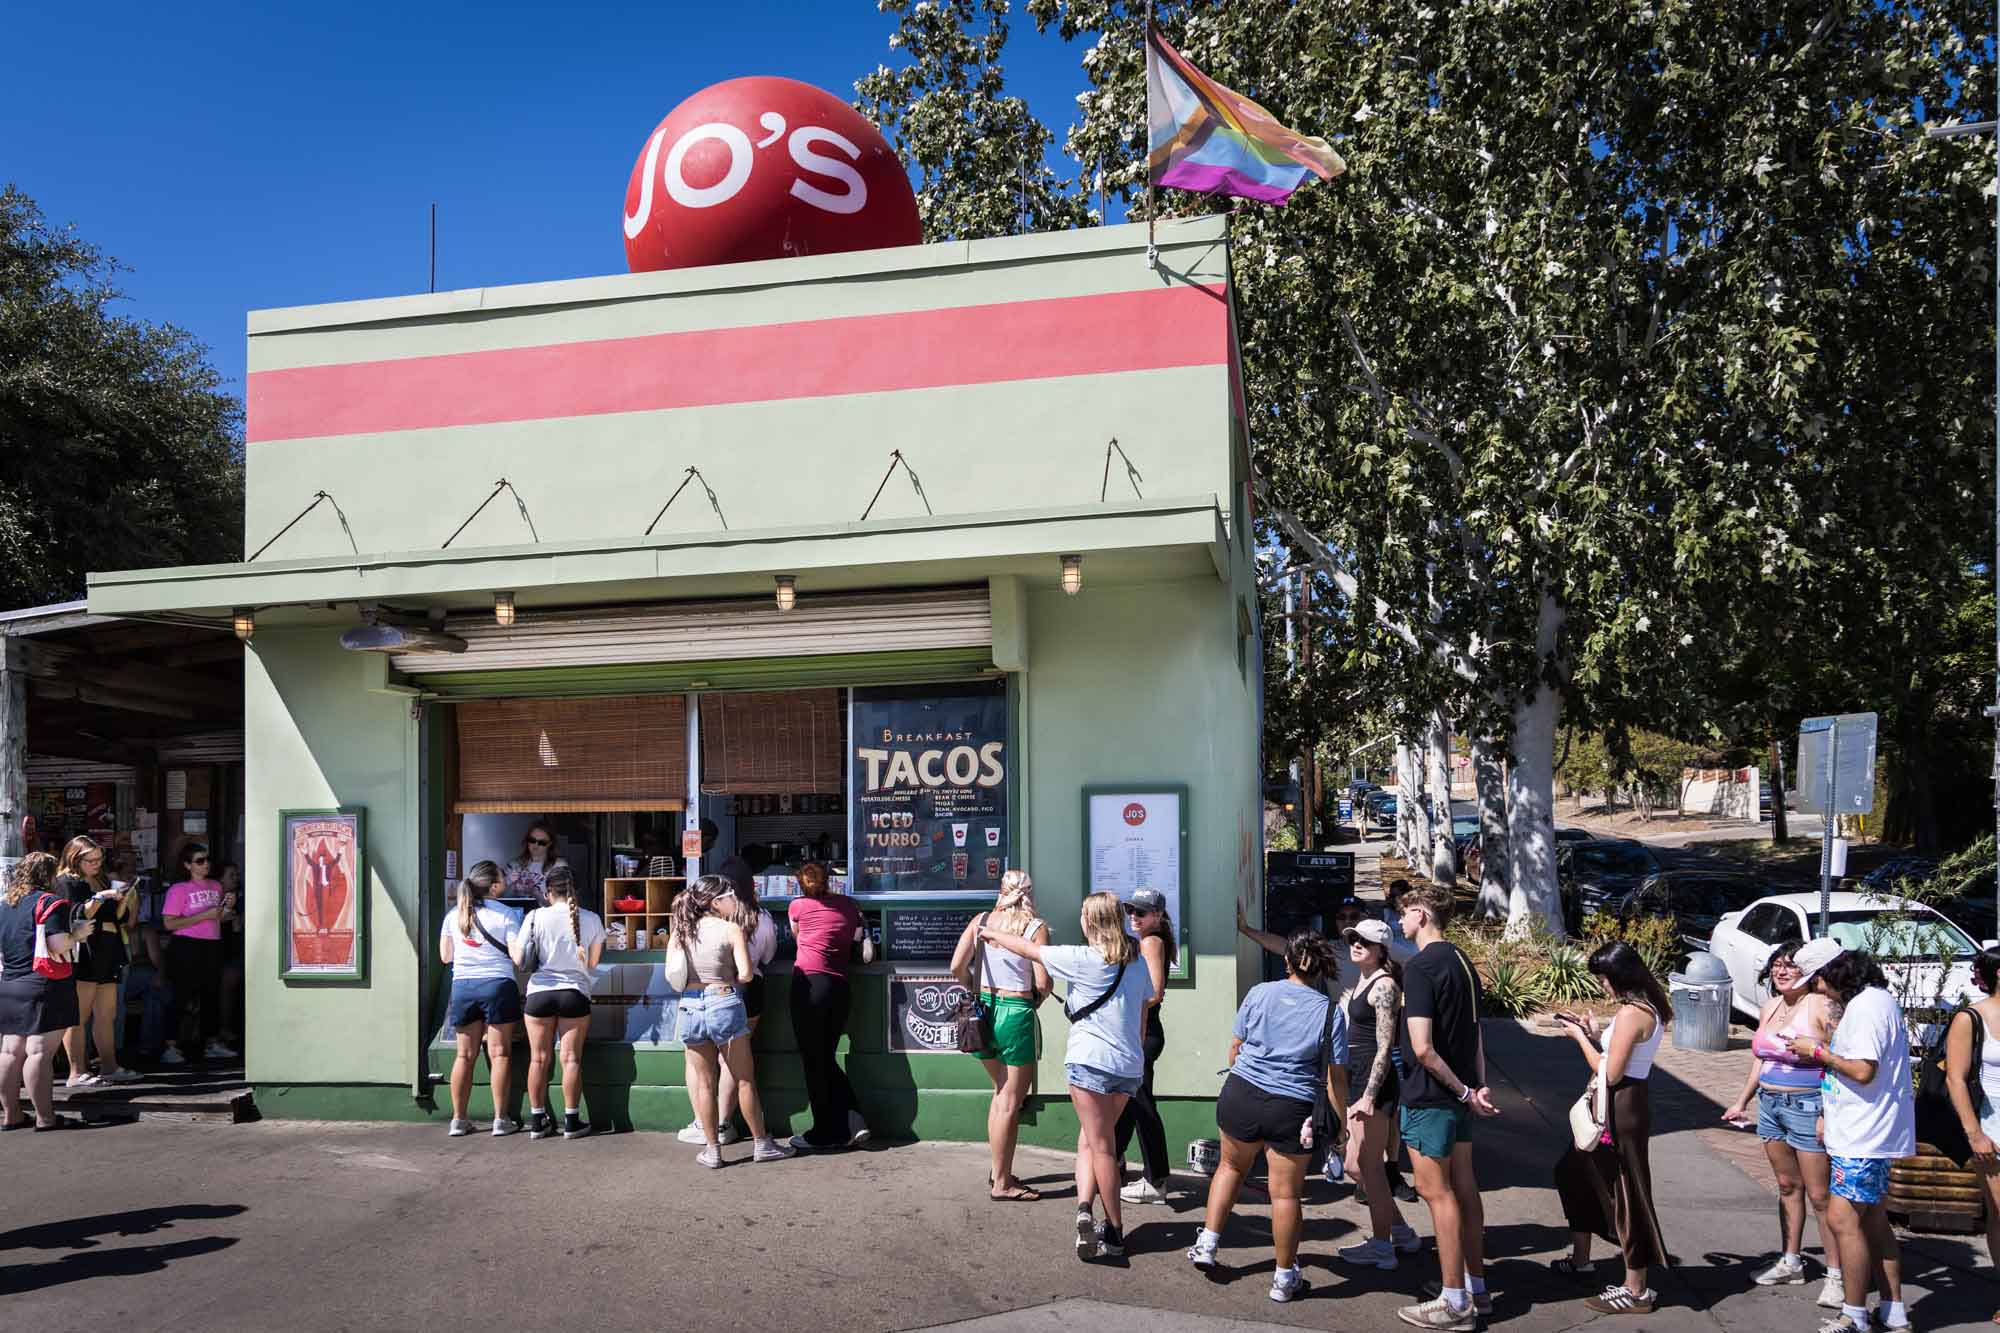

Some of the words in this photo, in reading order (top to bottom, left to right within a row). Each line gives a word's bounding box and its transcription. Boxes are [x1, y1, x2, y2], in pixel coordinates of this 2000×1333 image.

[624, 112, 868, 240] JO'S
[883, 729, 973, 742] BREAKFAST
[858, 742, 1004, 793] TACOS
[871, 811, 913, 829] ICED
[866, 832, 921, 849] TURBO
[1310, 857, 1337, 865] ATM
[919, 991, 938, 1008] STAY
